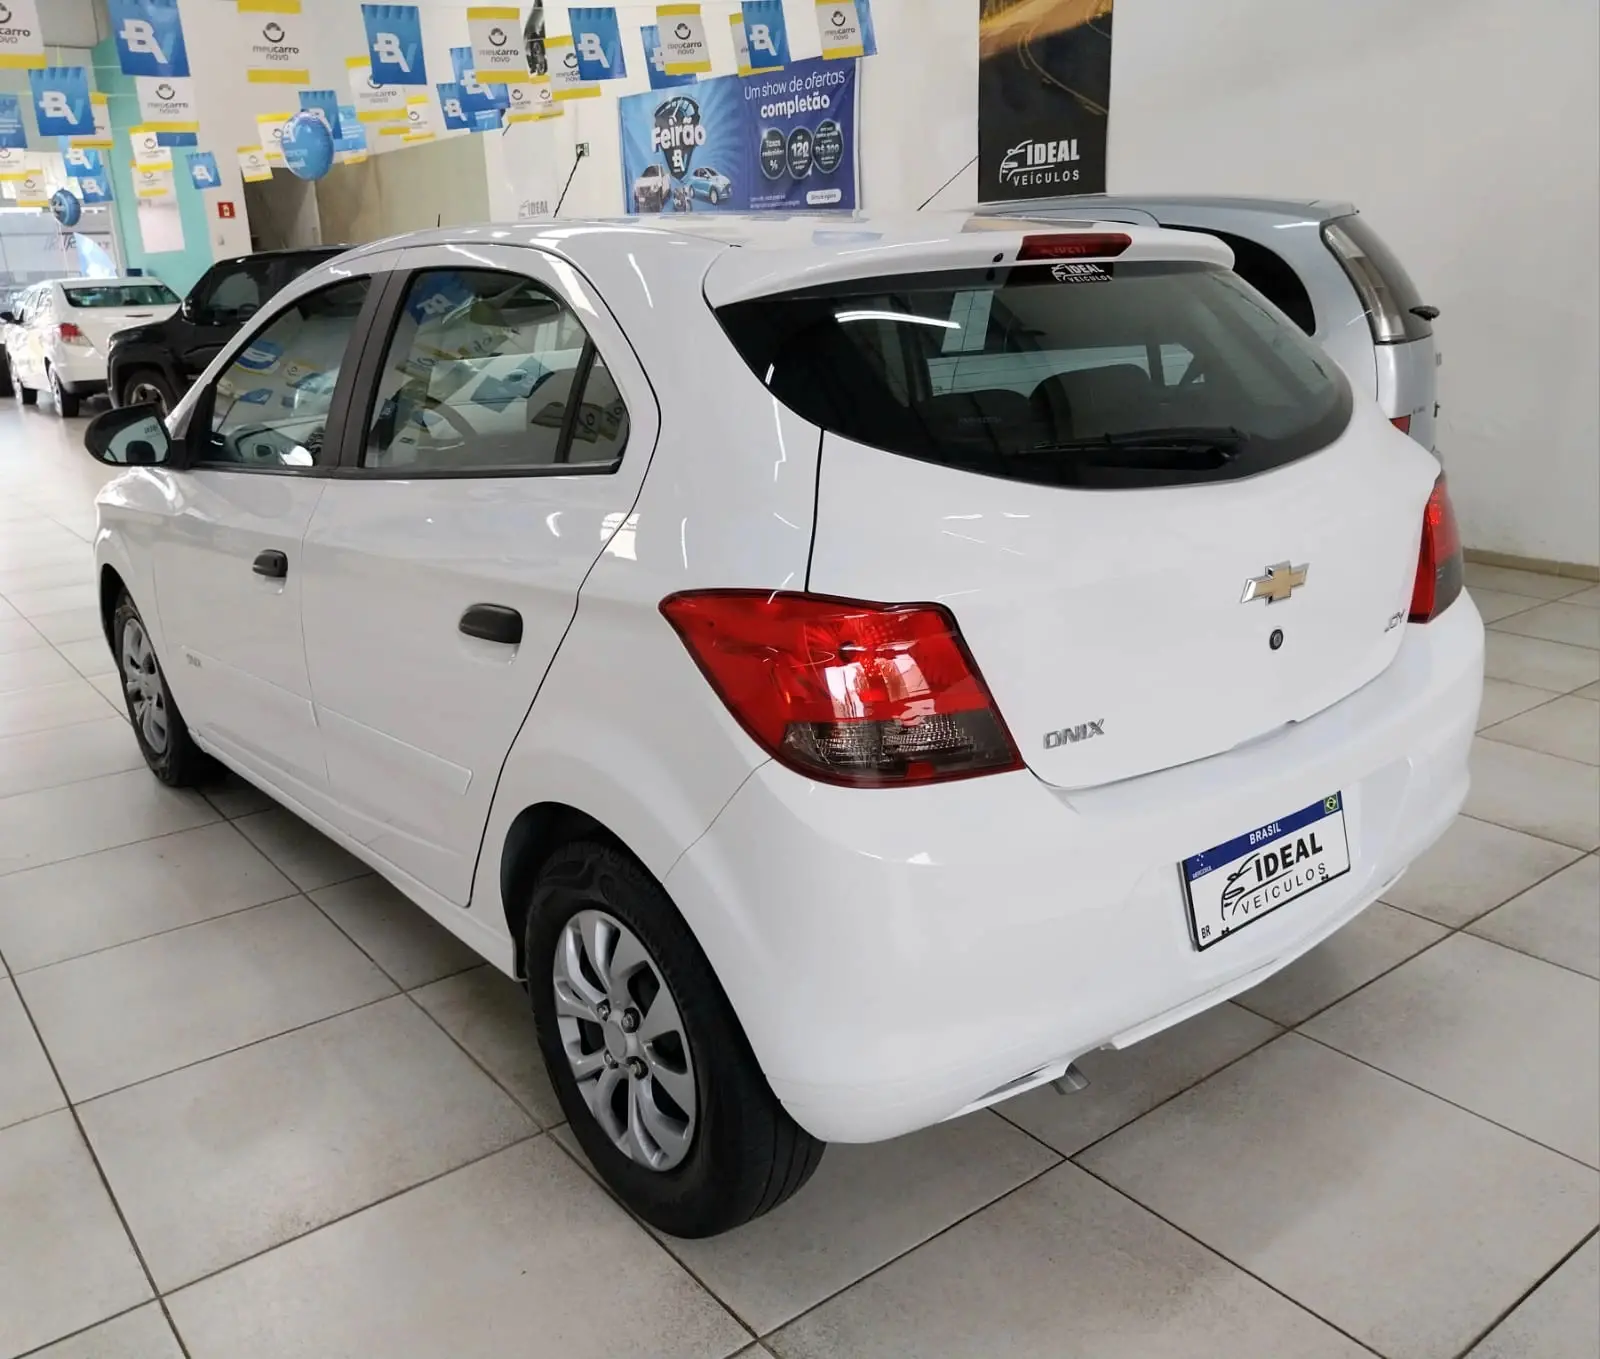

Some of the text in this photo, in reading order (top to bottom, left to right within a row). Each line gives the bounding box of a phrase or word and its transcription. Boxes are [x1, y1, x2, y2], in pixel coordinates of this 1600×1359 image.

[0, 28, 31, 37] carro
[252, 45, 300, 54] meucarro
[265, 53, 289, 61] novo
[744, 70, 846, 100] Um show de ofertas
[760, 92, 831, 120] completão
[651, 117, 707, 153] Feirão
[1026, 139, 1080, 166] IDEAL
[1013, 169, 1080, 187] VEÍCULOS
[1064, 263, 1105, 274] IDEAL
[1043, 718, 1105, 750] ONIX
[1249, 822, 1282, 845] BRASIL
[1255, 832, 1323, 883] IDEAL
[1241, 862, 1327, 915] VEÍCULOS
[1201, 925, 1212, 939] BR
